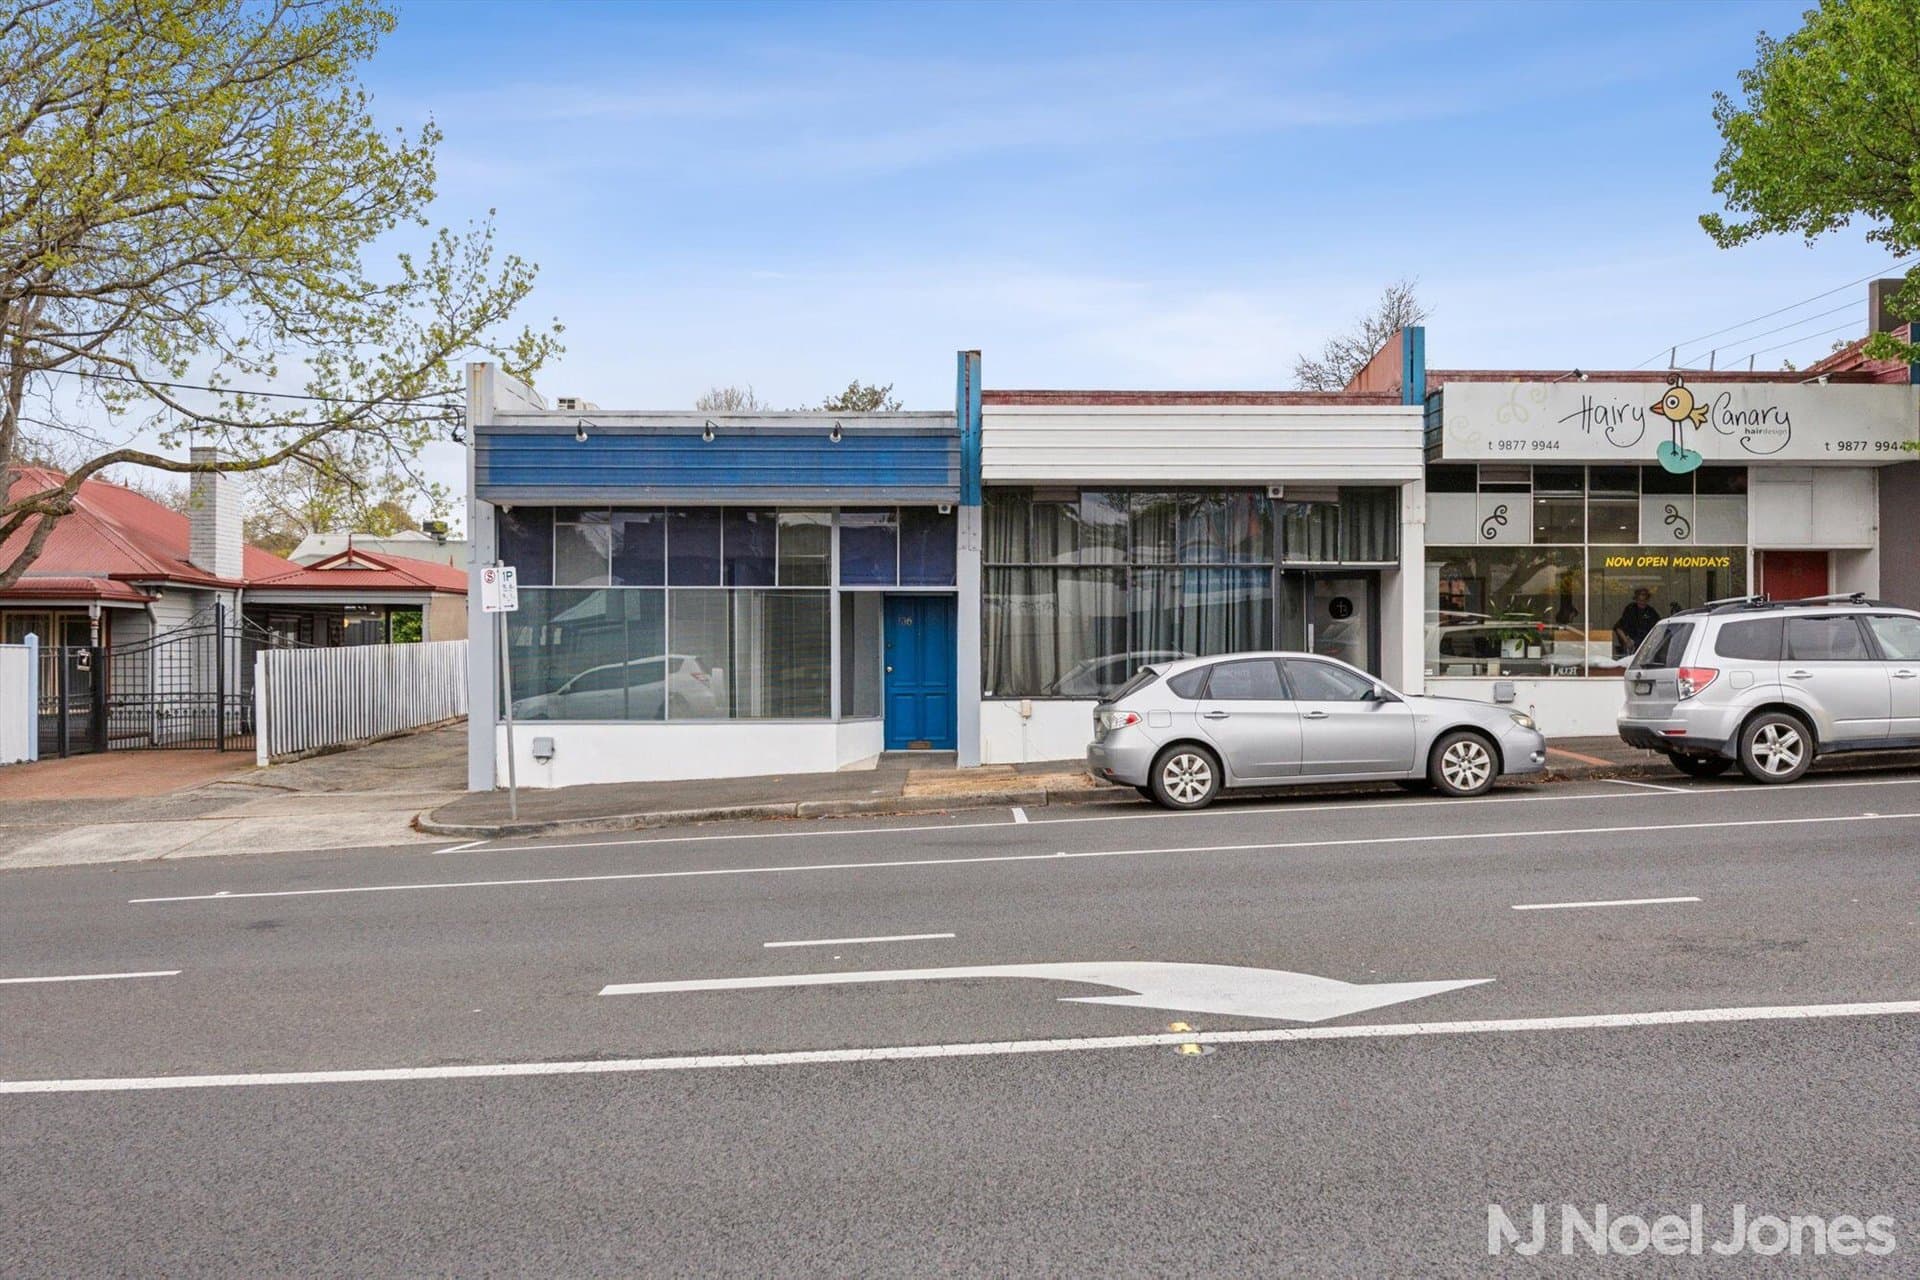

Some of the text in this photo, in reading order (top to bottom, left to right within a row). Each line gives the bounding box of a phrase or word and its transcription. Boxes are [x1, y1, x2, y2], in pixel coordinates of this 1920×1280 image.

[1558, 391, 1791, 454] Hairy Canary
[1498, 440, 1527, 450] 9877
[1531, 440, 1560, 450] 9944
[1837, 441, 1868, 451] 9877
[1605, 557, 1730, 567] NOW OPEN MONDAYS
